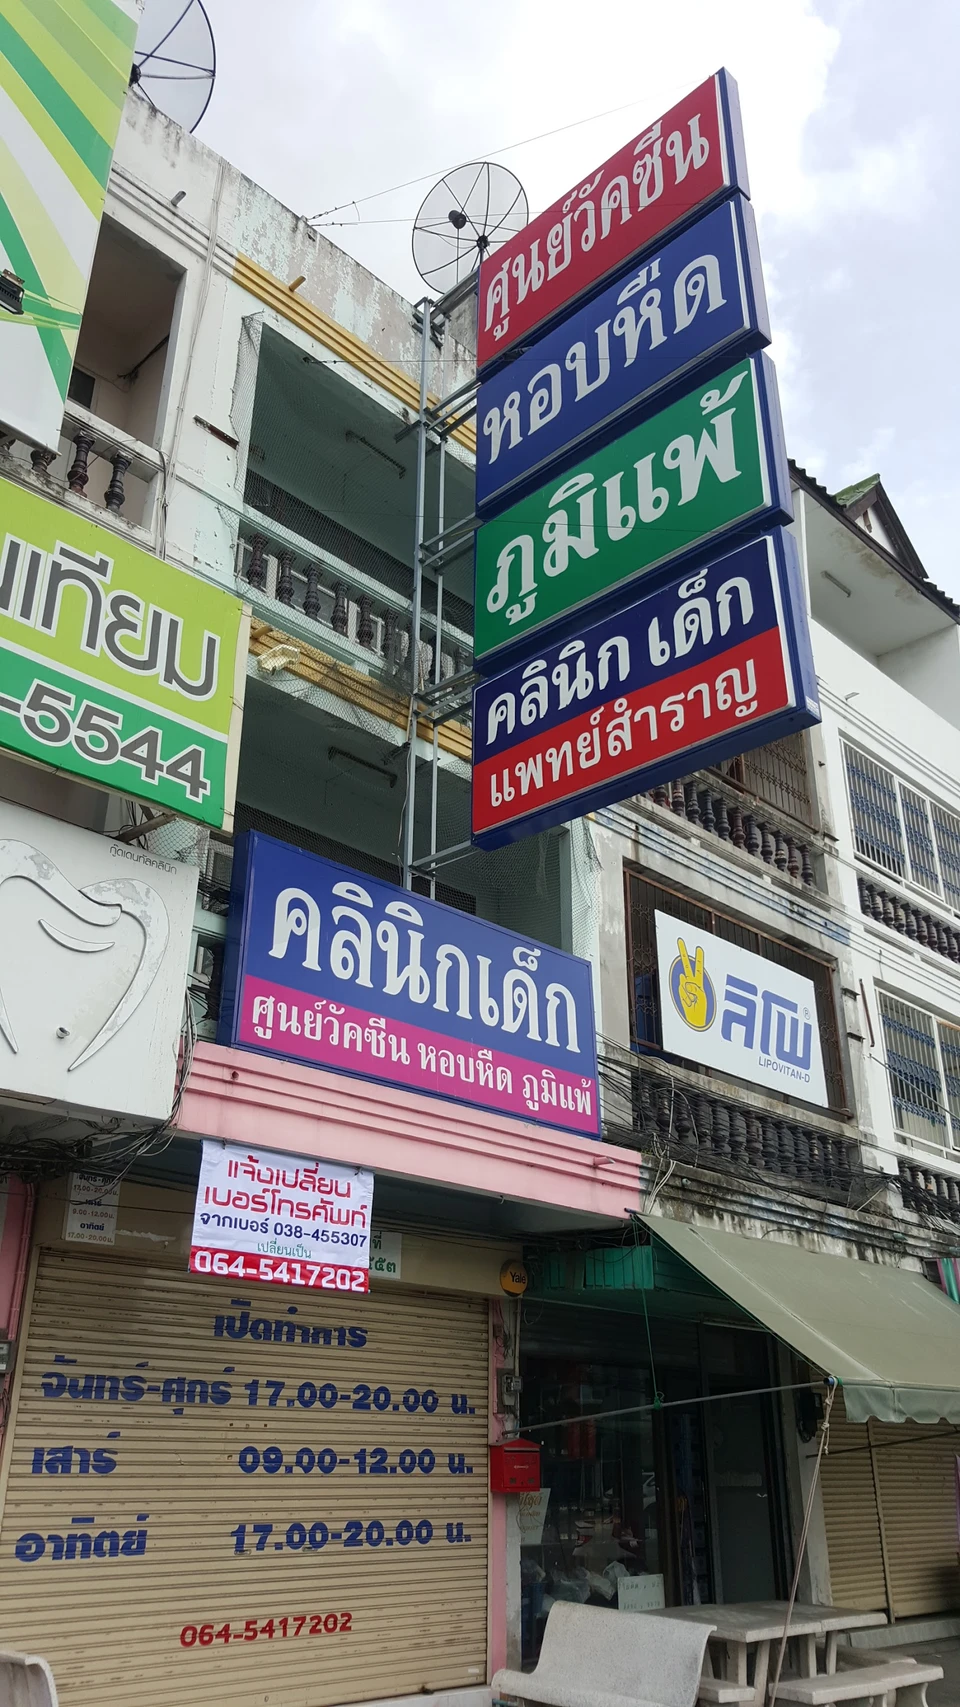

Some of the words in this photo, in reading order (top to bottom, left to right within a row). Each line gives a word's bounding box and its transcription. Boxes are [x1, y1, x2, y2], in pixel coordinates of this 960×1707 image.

[484, 113, 710, 341] ศูนย์วัคซีน
[483, 257, 727, 464] หอบหืด
[486, 370, 748, 625] ภูมิแพ้
[486, 638, 630, 745] คลินิก
[648, 568, 753, 667] เด็ก
[490, 659, 758, 807] แพทย์สำราญ
[268, 881, 581, 1053] คลินิกเด็ก
[252, 994, 411, 1065] ศูนย์วัคซีน
[417, 1042, 513, 1094] หอบหืด
[522, 1069, 592, 1116] ภูมิแพ้
[758, 1056, 811, 1083] LIPOVITAN-D
[227, 1155, 351, 1198] แจ้งเปลี่ยน
[200, 1212, 270, 1234] จากเบอร์
[273, 1222, 367, 1248] 038-455307
[204, 1186, 368, 1228] เบอร์โทรศัพท์
[194, 1250, 365, 1292] 064-5417202
[257, 1238, 312, 1259] เปลี่ยนเป็น
[509, 1271, 526, 1284] Yale
[213, 1300, 368, 1348] เปิดทำการ
[41, 1355, 236, 1415] จันทร์-ศุกร์
[243, 1379, 439, 1413] 17.00-20.00
[450, 1392, 476, 1415] น.
[31, 1431, 121, 1475] เสาร์
[238, 1446, 436, 1475] 09.00-12.00
[448, 1453, 474, 1474] น.
[14, 1514, 150, 1563] อาทิตย์
[230, 1519, 434, 1556] 17.00-20.00
[446, 1521, 472, 1543] น.
[180, 1612, 353, 1648] 064-5417202
